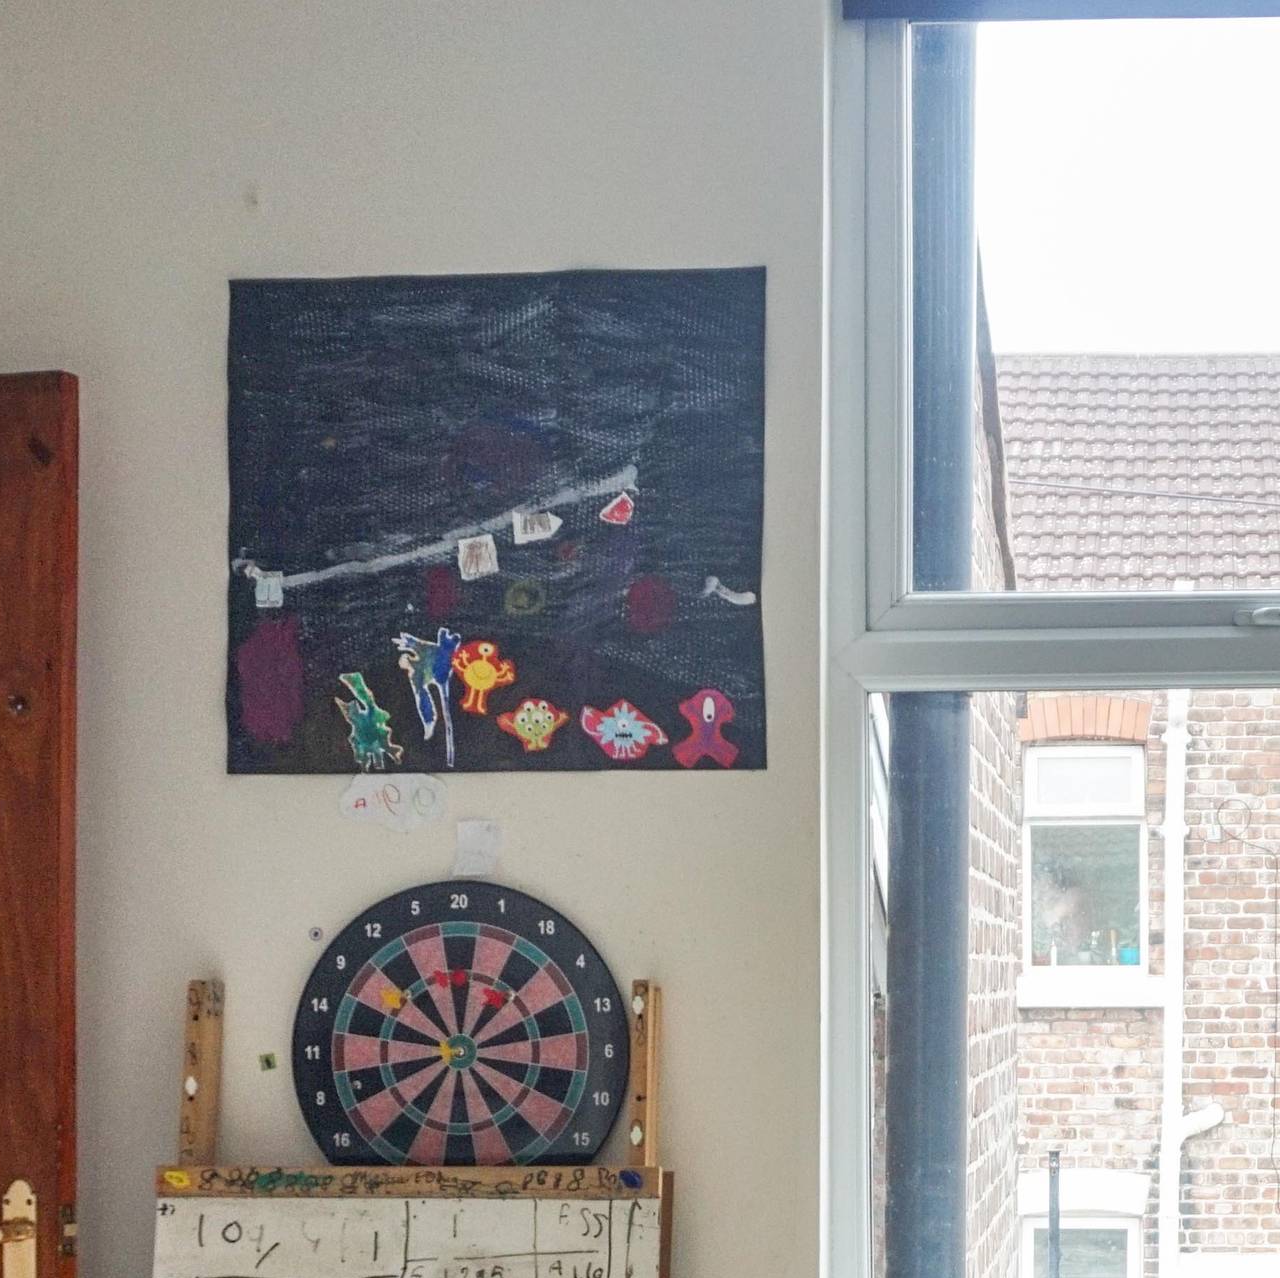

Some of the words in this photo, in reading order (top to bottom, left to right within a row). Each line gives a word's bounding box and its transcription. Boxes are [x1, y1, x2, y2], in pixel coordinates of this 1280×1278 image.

[411, 901, 420, 915] 5
[450, 894, 469, 908] 20
[497, 899, 505, 912] 1
[364, 923, 382, 937] 12
[538, 920, 555, 934] 18
[336, 956, 346, 969] 9
[576, 954, 585, 968] 4
[311, 998, 329, 1011] 14
[593, 998, 611, 1012] 13
[304, 1046, 320, 1059] 11
[604, 1044, 614, 1058] 6
[316, 1091, 326, 1105] 8
[592, 1092, 610, 1105] 10
[333, 1132, 351, 1146] 16
[572, 1132, 590, 1145] 15
